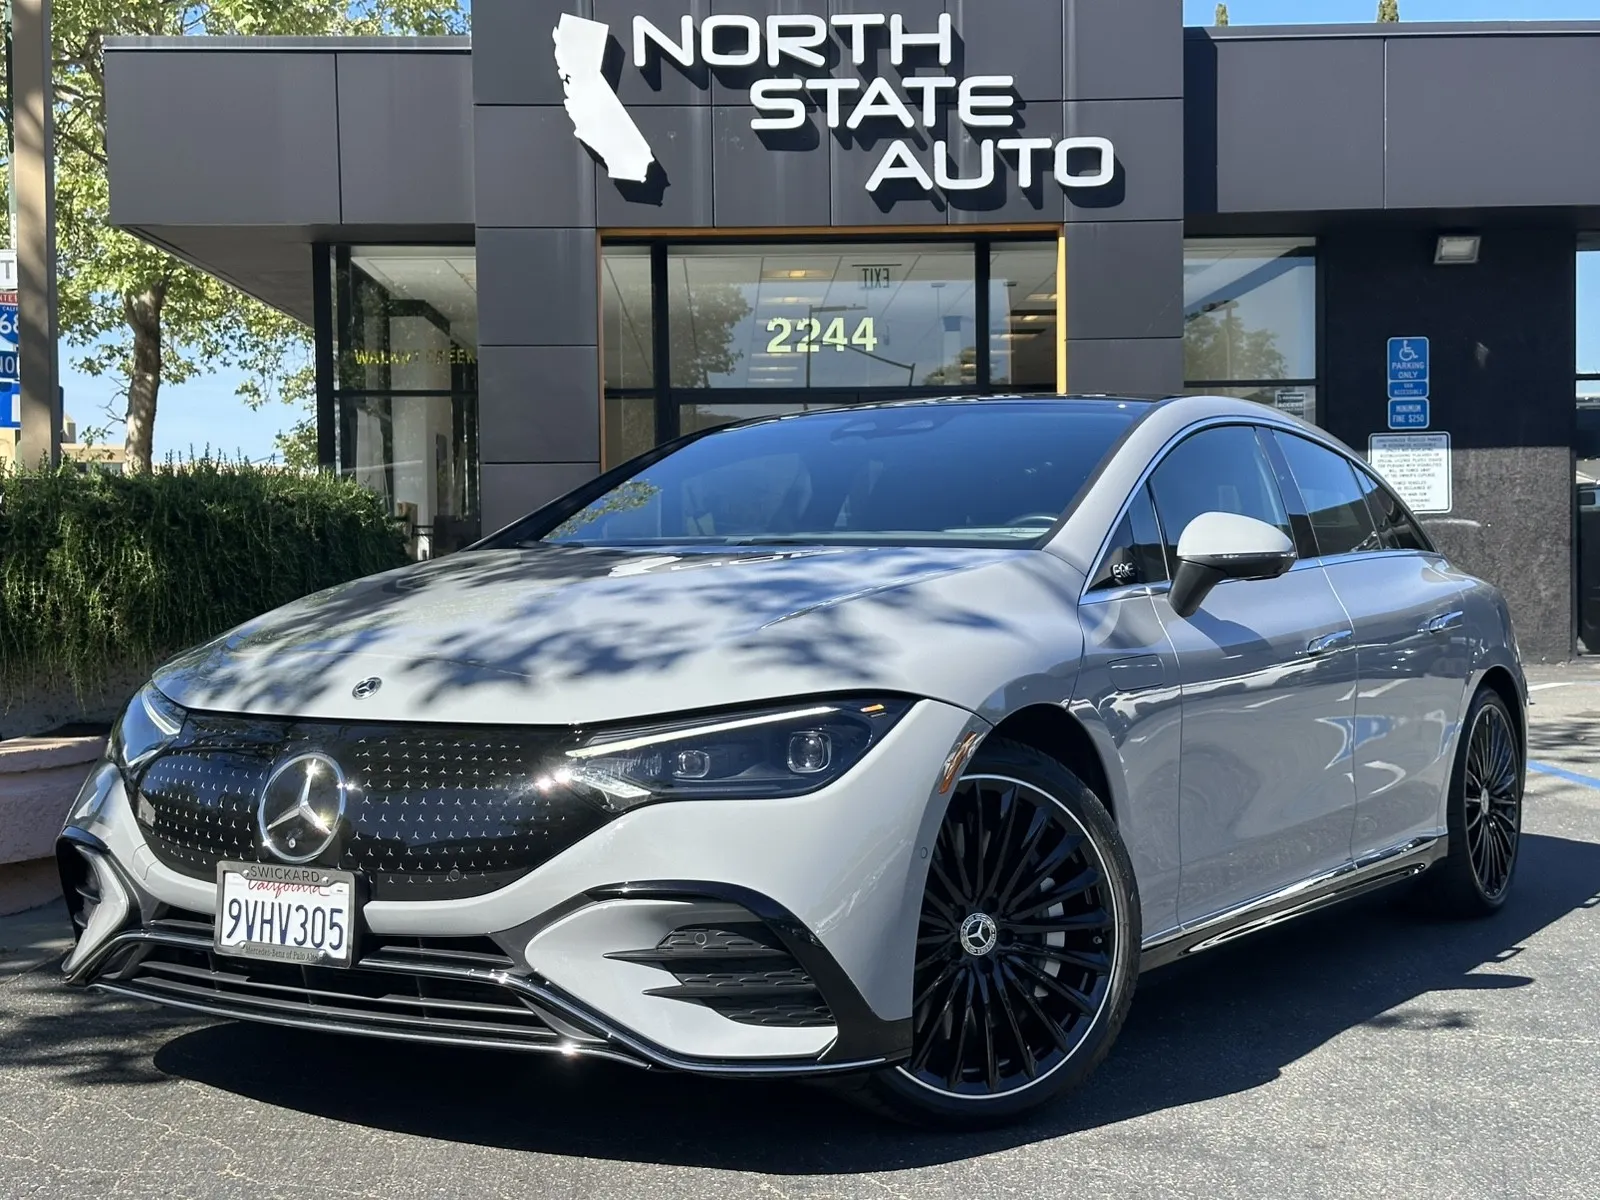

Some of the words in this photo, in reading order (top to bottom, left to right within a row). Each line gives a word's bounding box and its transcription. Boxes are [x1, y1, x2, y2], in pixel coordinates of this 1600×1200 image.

[632, 13, 952, 68] NORTH
[749, 75, 1014, 130] STATE
[865, 136, 1115, 192] AUTO
[766, 316, 878, 353] 2244
[1391, 361, 1424, 370] PARKING
[1398, 371, 1418, 379] ONLY
[1408, 413, 1424, 423] $250
[250, 865, 320, 883] SWICKARD
[226, 898, 344, 950] 9VHV305
